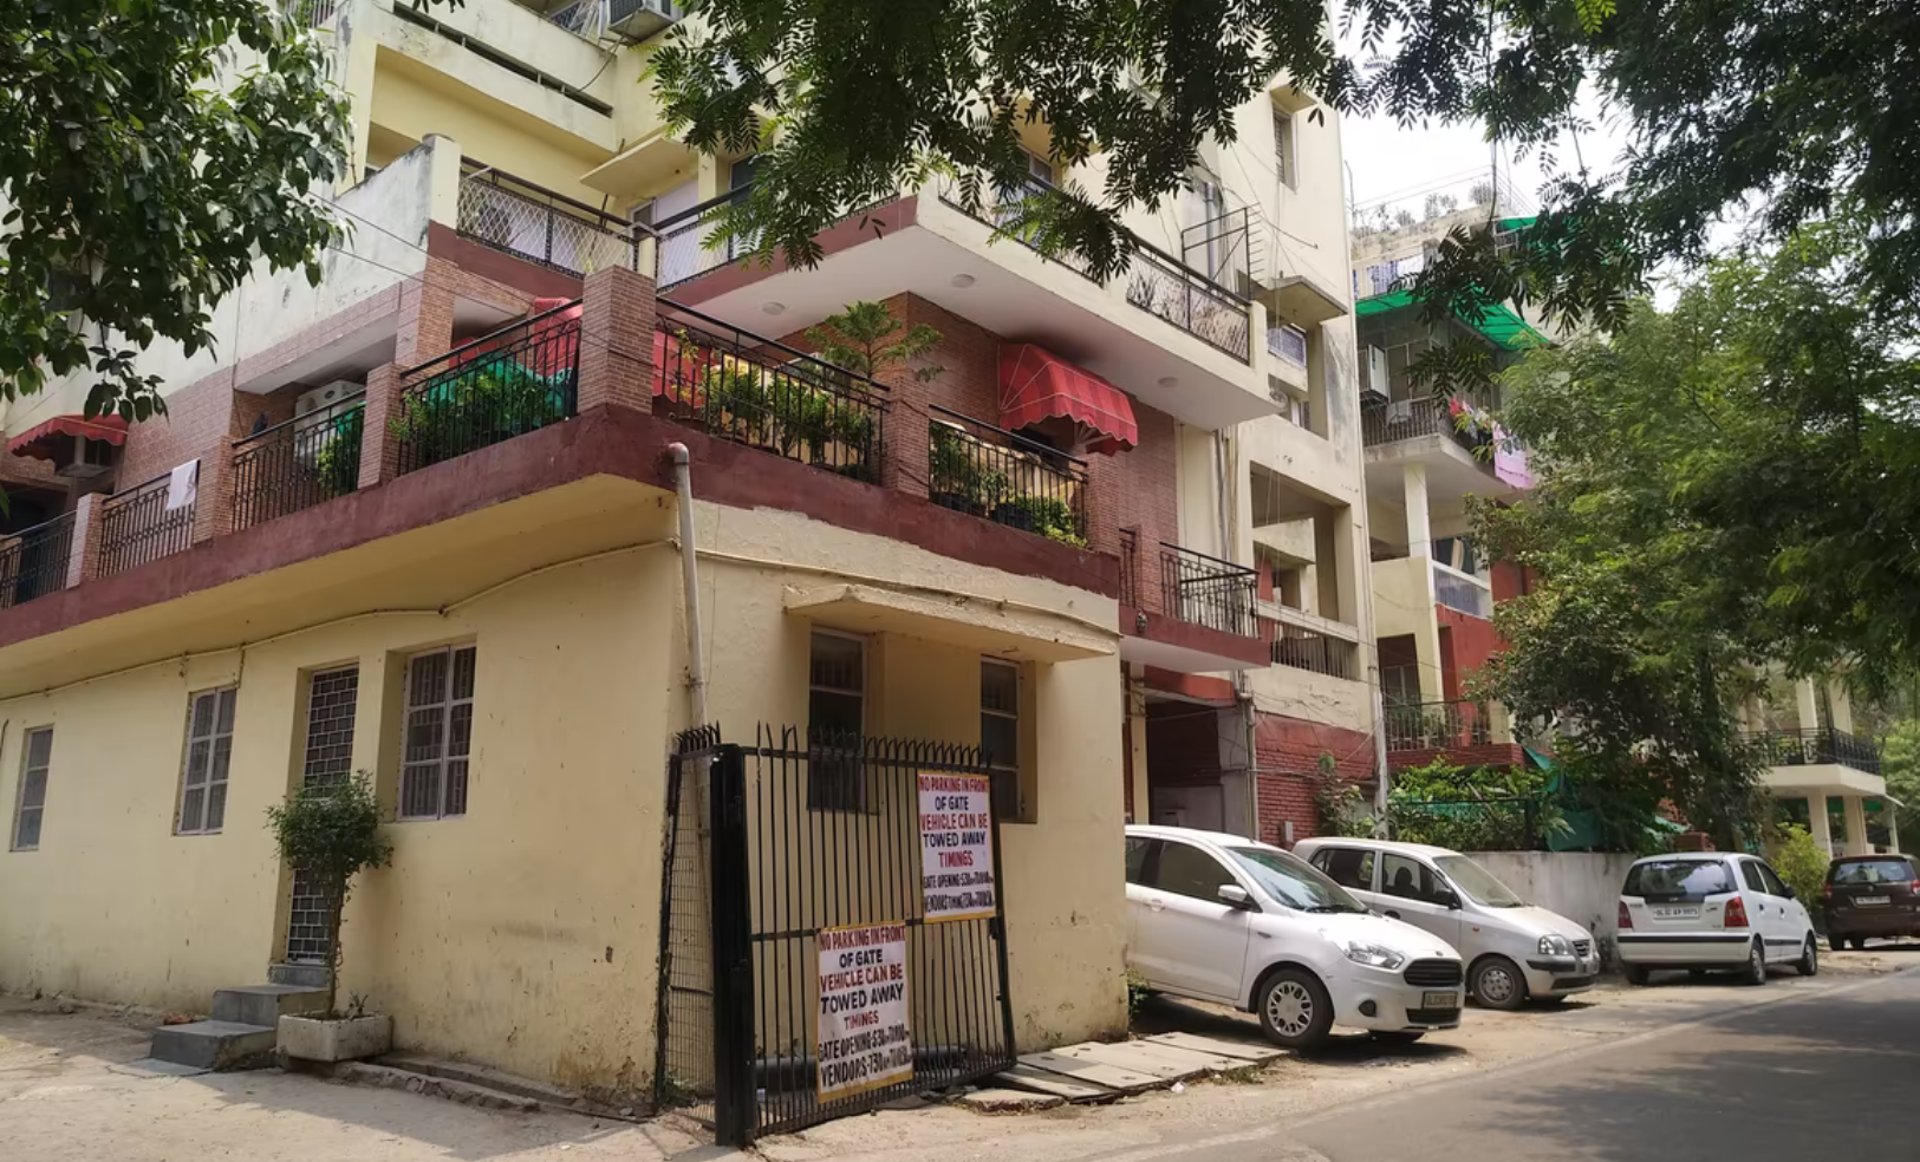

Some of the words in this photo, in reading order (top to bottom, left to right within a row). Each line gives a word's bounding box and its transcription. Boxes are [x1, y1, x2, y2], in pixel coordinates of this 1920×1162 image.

[919, 776, 929, 791] NO
[931, 777, 961, 792] PARKING
[962, 778, 969, 792] IN
[970, 779, 988, 792] FRONT
[935, 796, 946, 810] OF
[949, 796, 969, 810] GATE
[921, 813, 956, 831] VEHICLE
[958, 813, 976, 829] CAN
[978, 813, 988, 829] BE
[923, 833, 959, 848] TOWED
[961, 831, 986, 846] AWAY
[938, 851, 974, 868] TIMINGS
[820, 933, 831, 951] NO
[832, 928, 869, 950] PARKING
[871, 927, 880, 945] IN
[881, 925, 905, 944] FRONT
[839, 952, 853, 968] OF
[856, 949, 883, 966] GATE
[820, 968, 864, 993] VEHICLE
[865, 965, 887, 985] CAN
[890, 963, 903, 980] BE
[820, 989, 867, 1015] TOWED
[870, 983, 904, 1006] AWAY
[844, 1010, 879, 1030] TIMINGS
[818, 1039, 839, 1062] GATE
